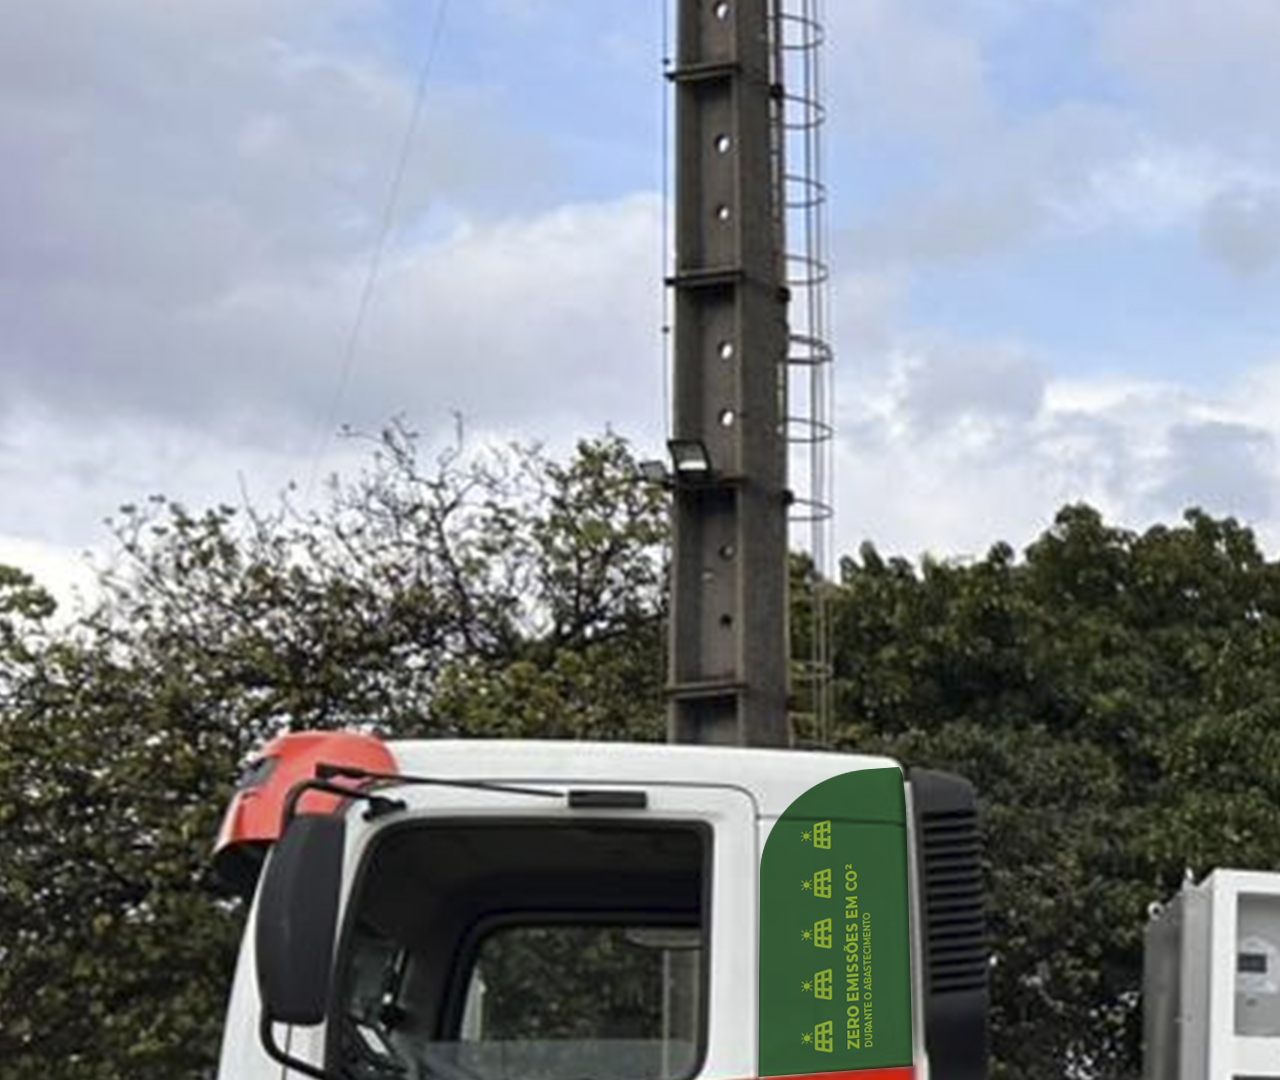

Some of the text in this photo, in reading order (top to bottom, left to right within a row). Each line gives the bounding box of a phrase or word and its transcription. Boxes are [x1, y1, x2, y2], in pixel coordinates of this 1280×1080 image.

[845, 895, 859, 919] EM
[843, 922, 860, 1002] EMISSÕES
[861, 912, 873, 1048] DURANTE O ABASTECIMENTO
[846, 1005, 861, 1050] ZERO
